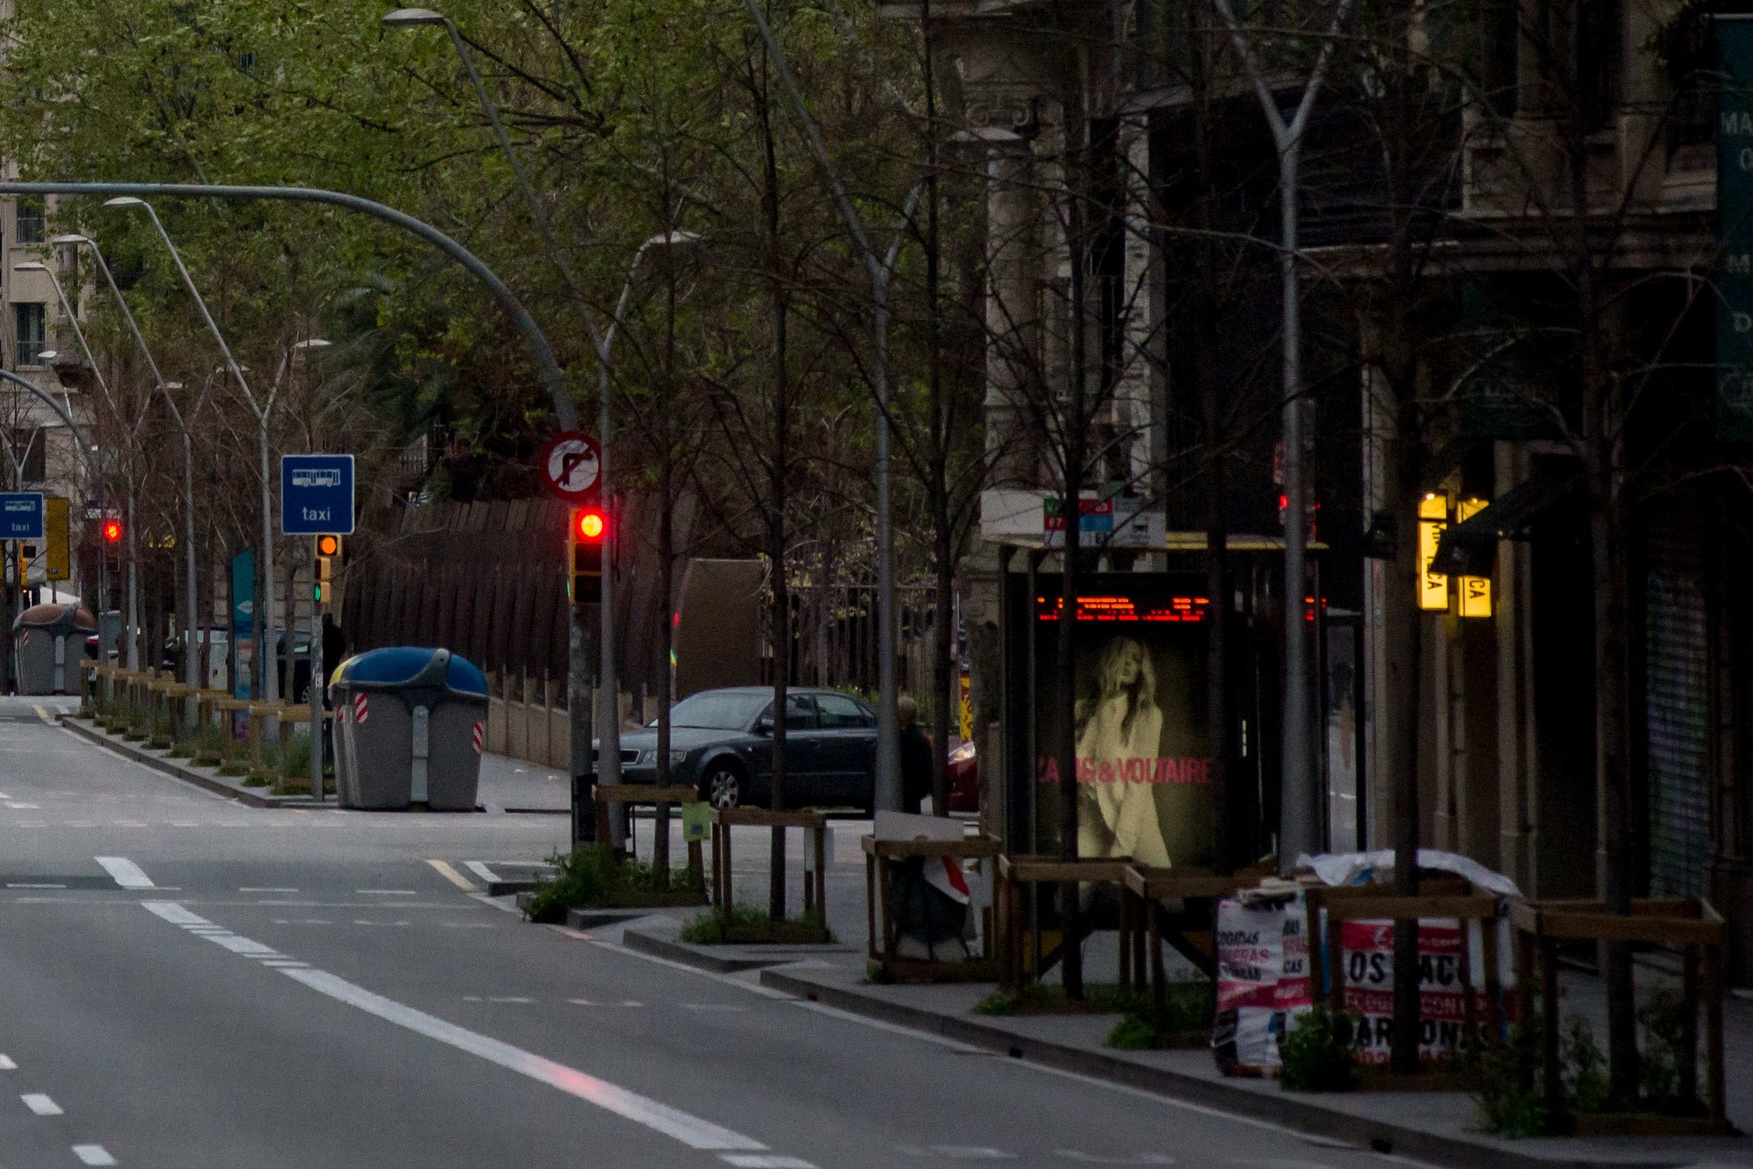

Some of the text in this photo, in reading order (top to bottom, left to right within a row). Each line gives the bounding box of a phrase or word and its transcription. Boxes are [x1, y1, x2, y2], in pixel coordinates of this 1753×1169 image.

[303, 506, 331, 521] taxi
[11, 522, 30, 532] taxi
[1098, 760, 1115, 783] &
[1118, 757, 1212, 784] VOLTAIRE
